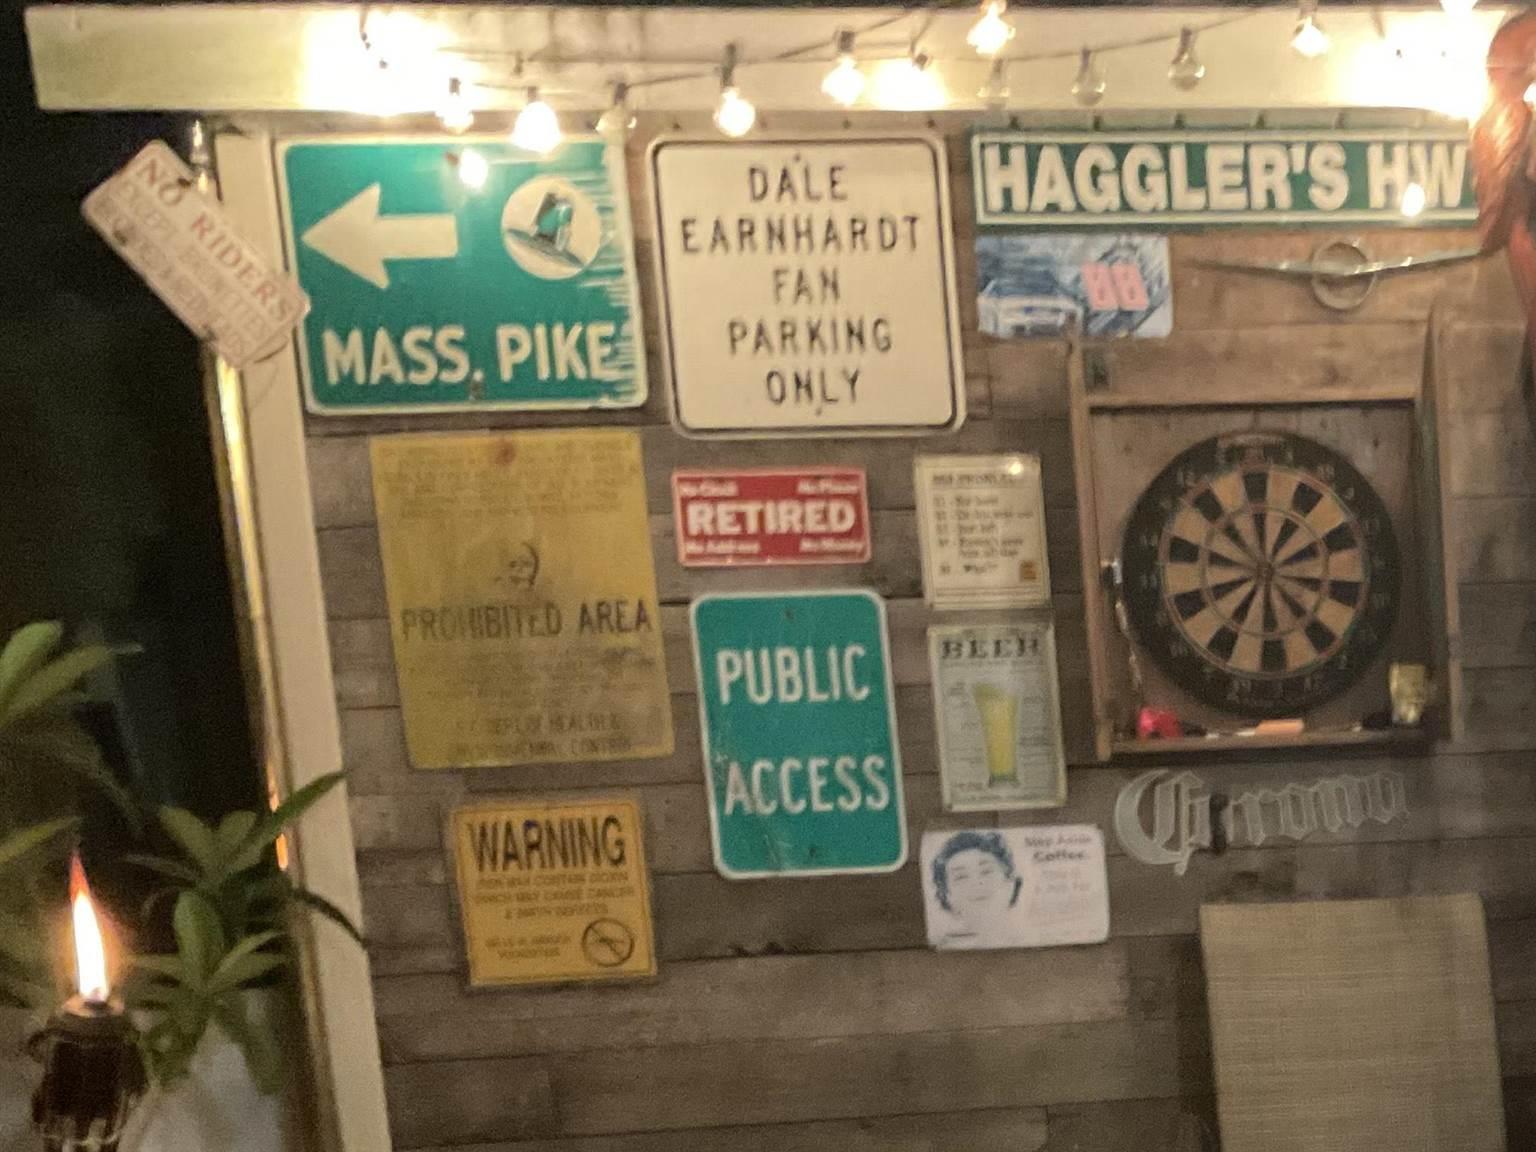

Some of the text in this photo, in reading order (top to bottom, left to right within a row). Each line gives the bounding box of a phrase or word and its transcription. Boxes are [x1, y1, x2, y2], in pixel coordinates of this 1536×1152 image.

[748, 163, 849, 201] DALE
[983, 141, 1350, 214] HAGGLER'S
[134, 158, 188, 211] NO
[186, 211, 298, 324] RIDERS
[680, 214, 921, 254] EARNHARDT
[773, 266, 841, 301] FAN
[322, 320, 629, 386] MASS. PIKE
[728, 317, 894, 355] PARKING
[765, 370, 861, 407] ONLY
[686, 500, 856, 537] RETIRED
[401, 597, 653, 642] PROHIBITED AREA
[941, 636, 1039, 661] BEER
[716, 644, 871, 706] PUBLIC
[723, 754, 890, 816] ACCESS
[471, 816, 627, 873] WARNING
